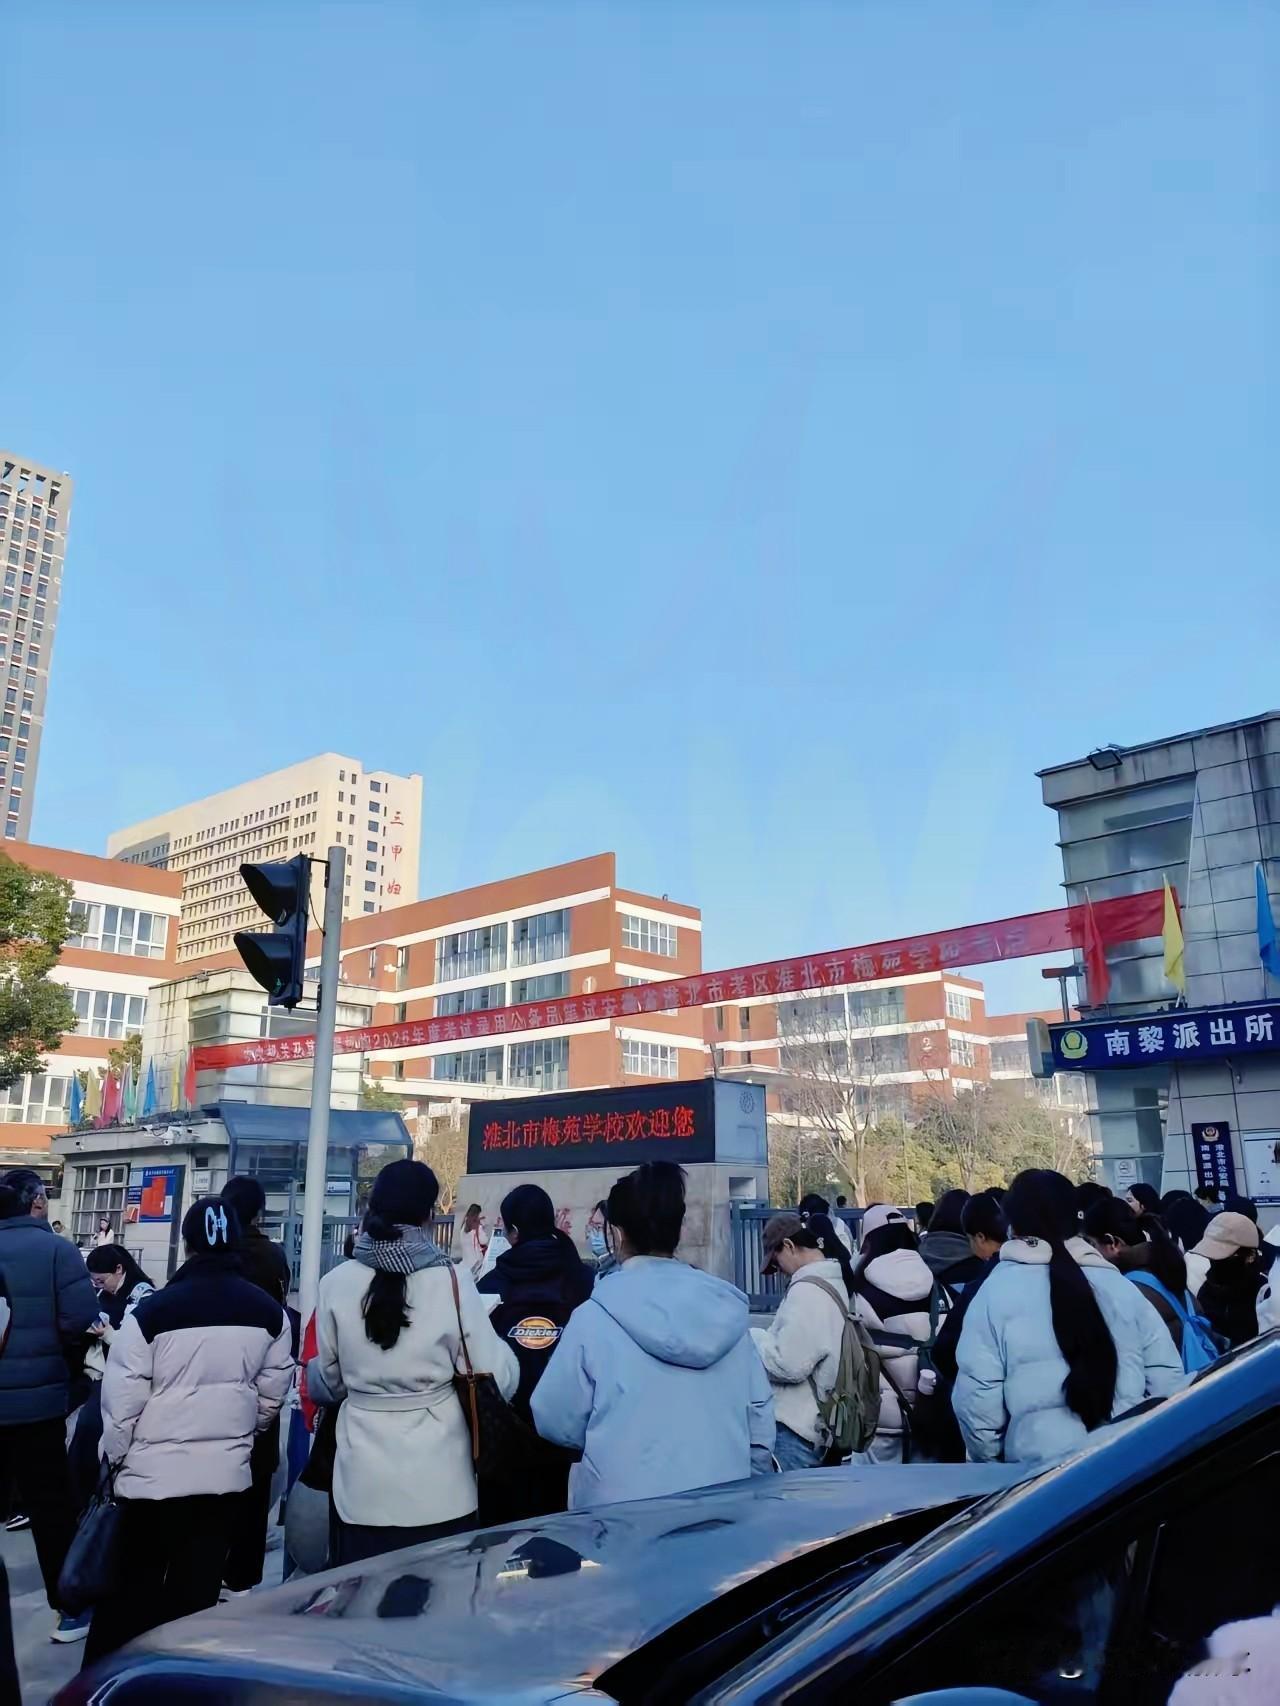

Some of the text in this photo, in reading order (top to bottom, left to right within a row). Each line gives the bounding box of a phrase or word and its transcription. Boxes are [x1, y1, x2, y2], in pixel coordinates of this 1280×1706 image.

[584, 976, 592, 993] 1
[1104, 1013, 1273, 1056] 南黎派出所
[483, 1105, 695, 1150] 淮北市梅苑学校欢迎您
[514, 1328, 558, 1337] Dickies
